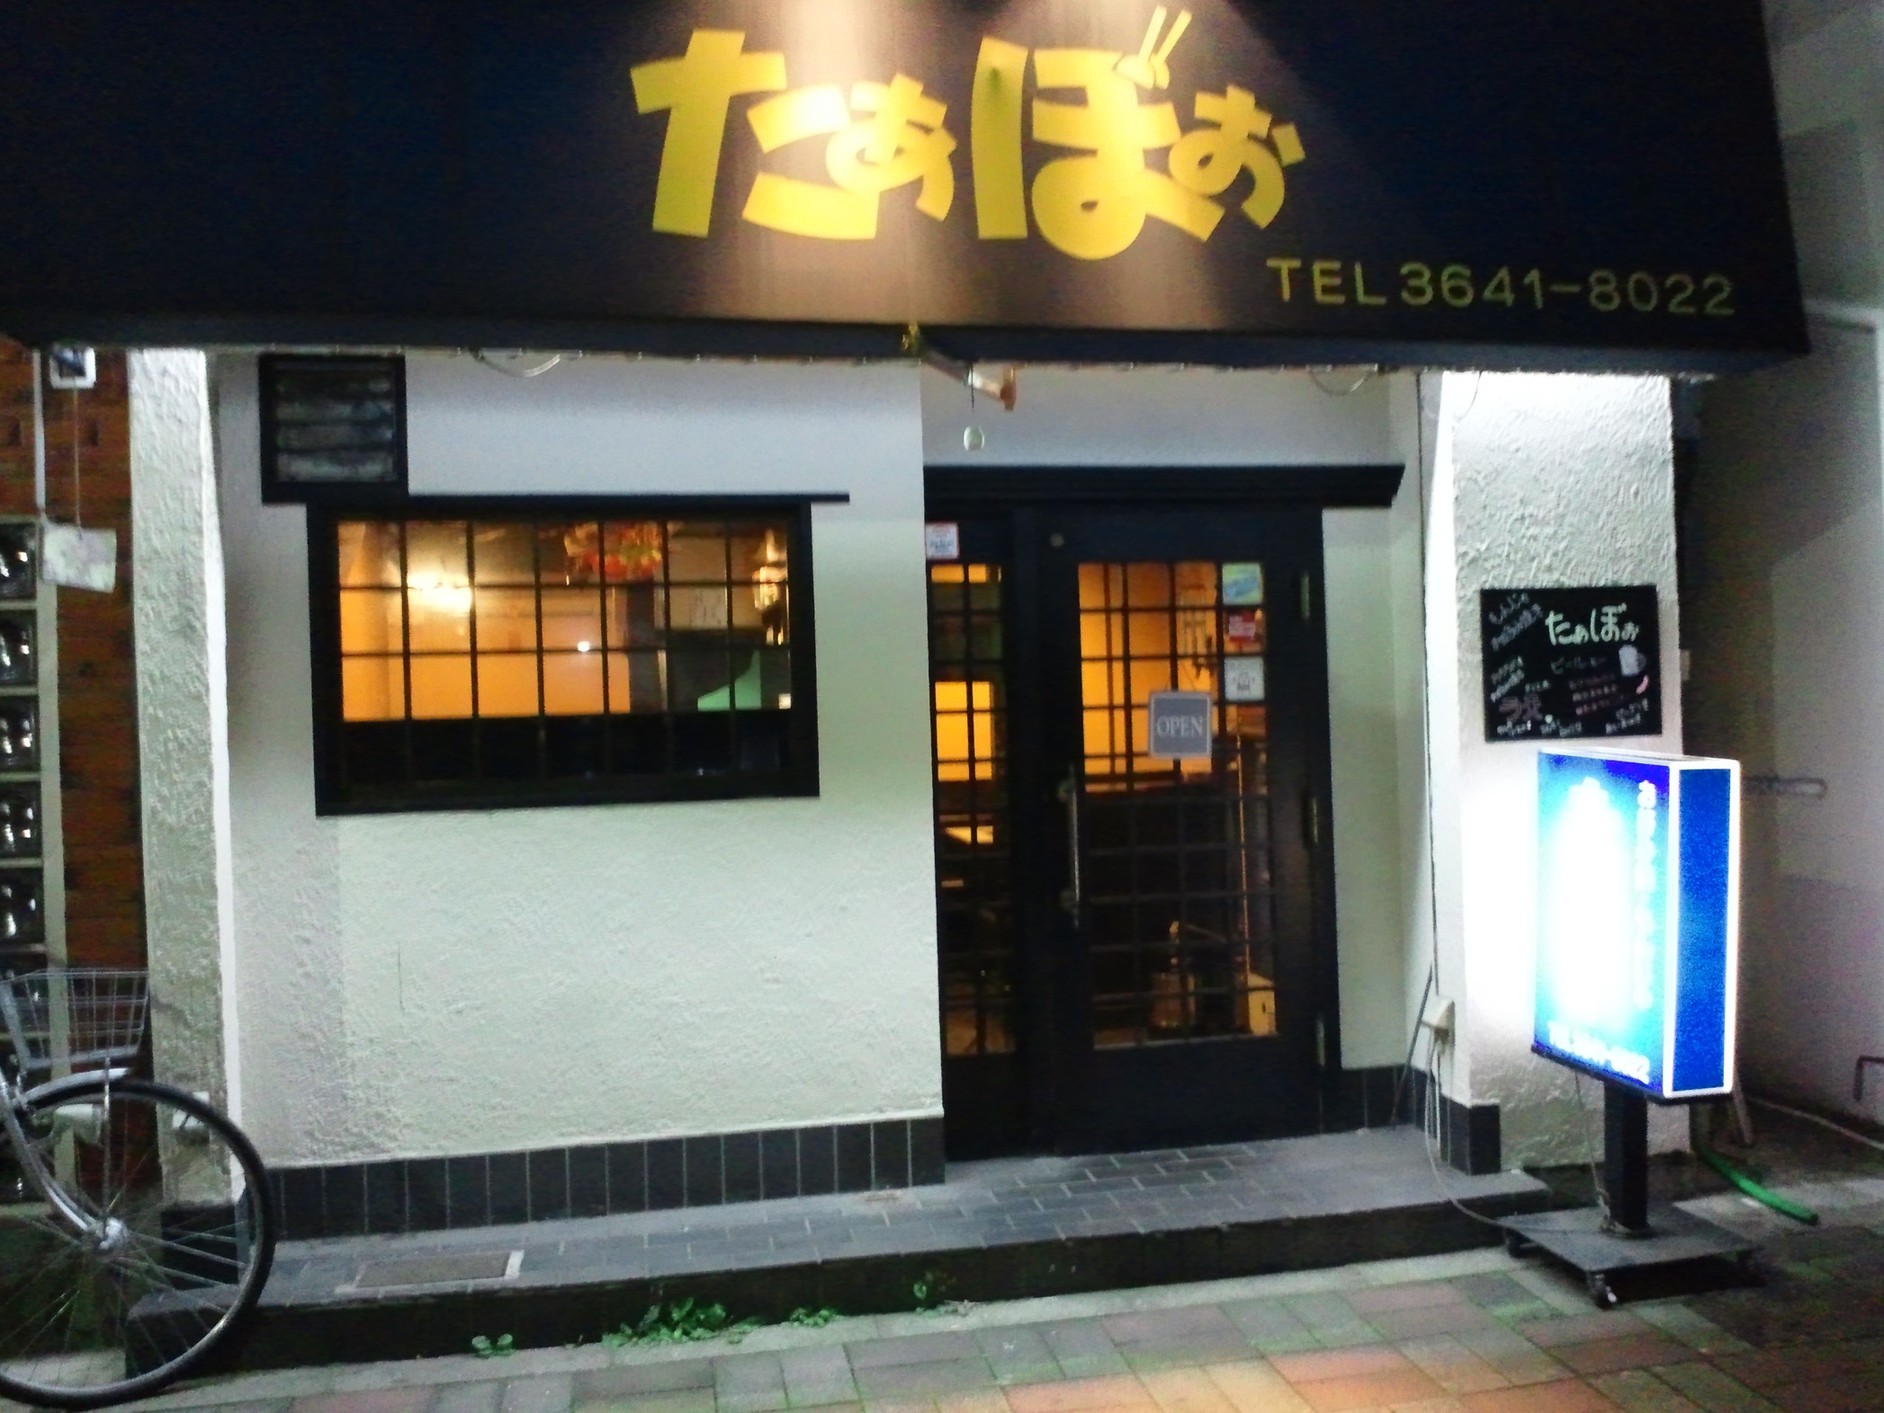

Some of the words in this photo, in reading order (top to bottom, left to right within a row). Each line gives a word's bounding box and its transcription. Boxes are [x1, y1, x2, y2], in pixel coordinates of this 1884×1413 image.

[629, 6, 1306, 260] たぁぼぉ
[1265, 257, 1387, 305] TEL
[1399, 261, 1736, 316] 3641-8022
[1156, 714, 1203, 739] OPEN
